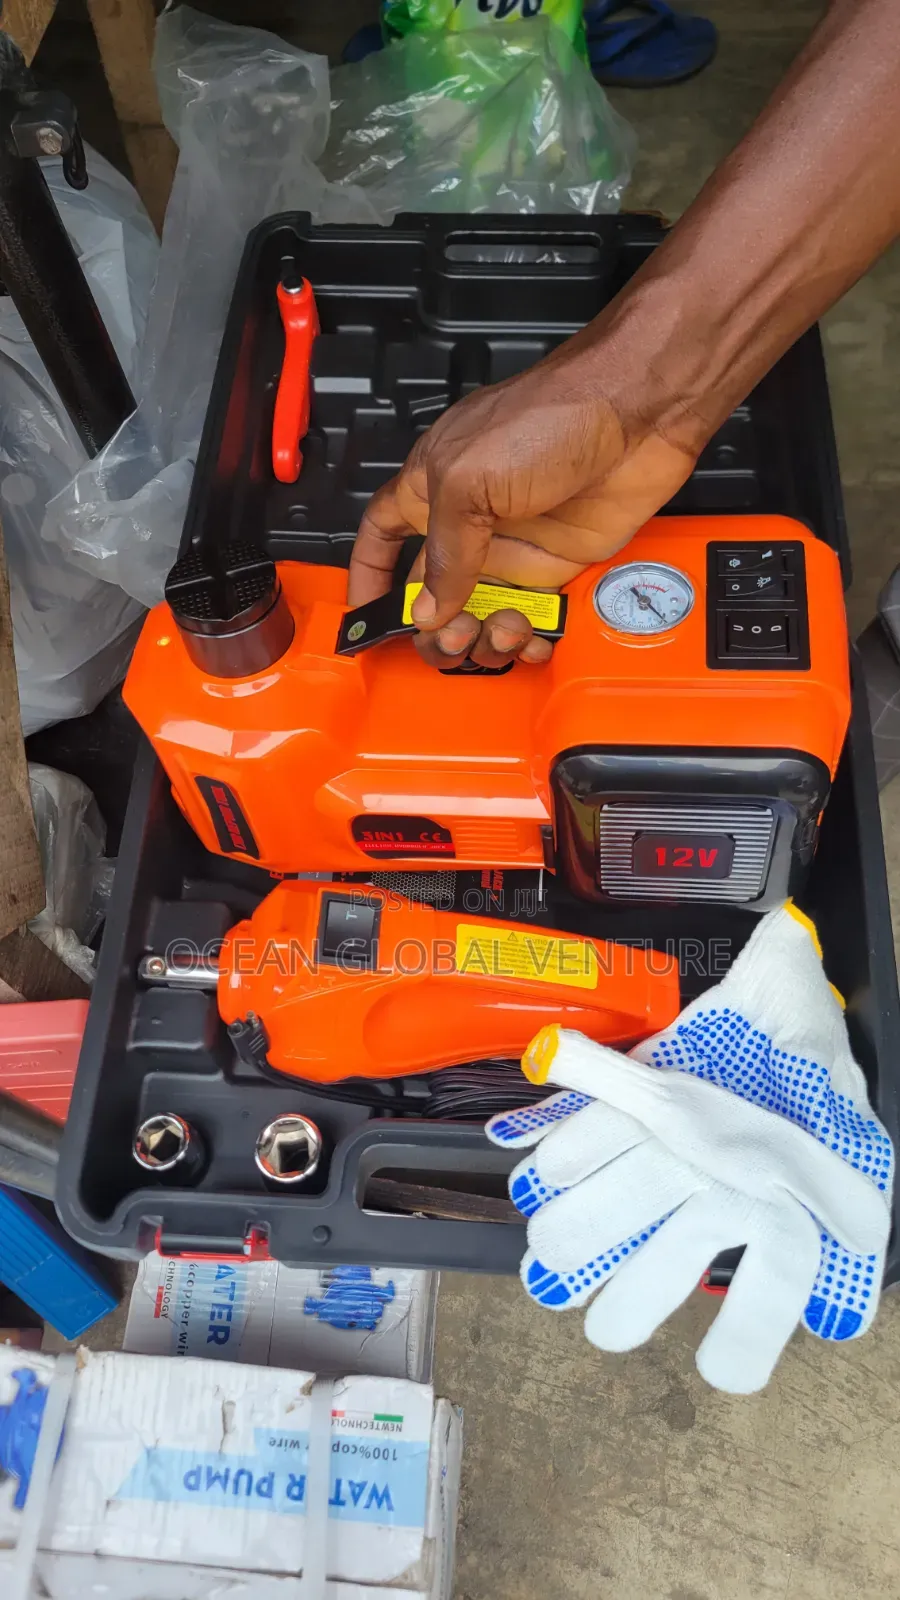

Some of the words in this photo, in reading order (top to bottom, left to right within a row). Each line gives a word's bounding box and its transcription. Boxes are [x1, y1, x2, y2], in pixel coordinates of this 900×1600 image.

[655, 847, 718, 868] 12V
[161, 1257, 176, 1319] CHNOLOGY
[177, 1332, 188, 1356] wir
[269, 1437, 300, 1452] wire
[183, 1465, 275, 1499] PUMP
[286, 1473, 394, 1511] WATR
